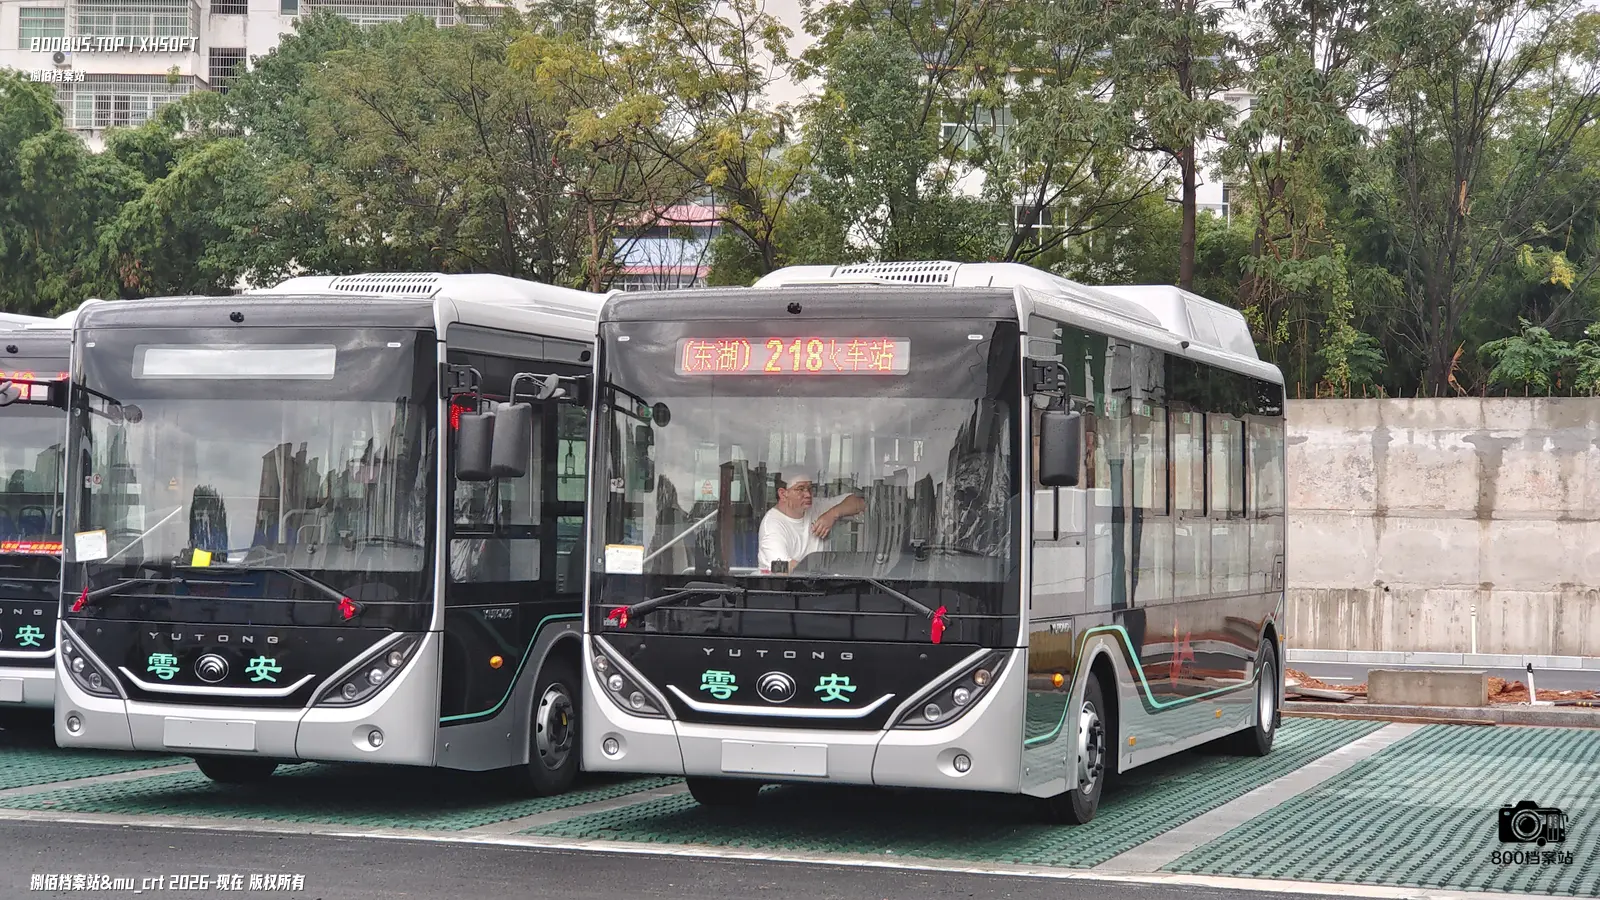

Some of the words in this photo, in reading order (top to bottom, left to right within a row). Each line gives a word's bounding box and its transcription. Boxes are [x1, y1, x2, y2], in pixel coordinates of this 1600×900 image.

[683, 339, 751, 372] (东湖)
[764, 338, 824, 372] 218
[0, 607, 43, 616] NG
[15, 624, 46, 647] 安
[149, 631, 279, 644] YUTONG
[702, 647, 854, 661] YUTONG
[244, 655, 283, 683] 安
[813, 672, 857, 703] 安
